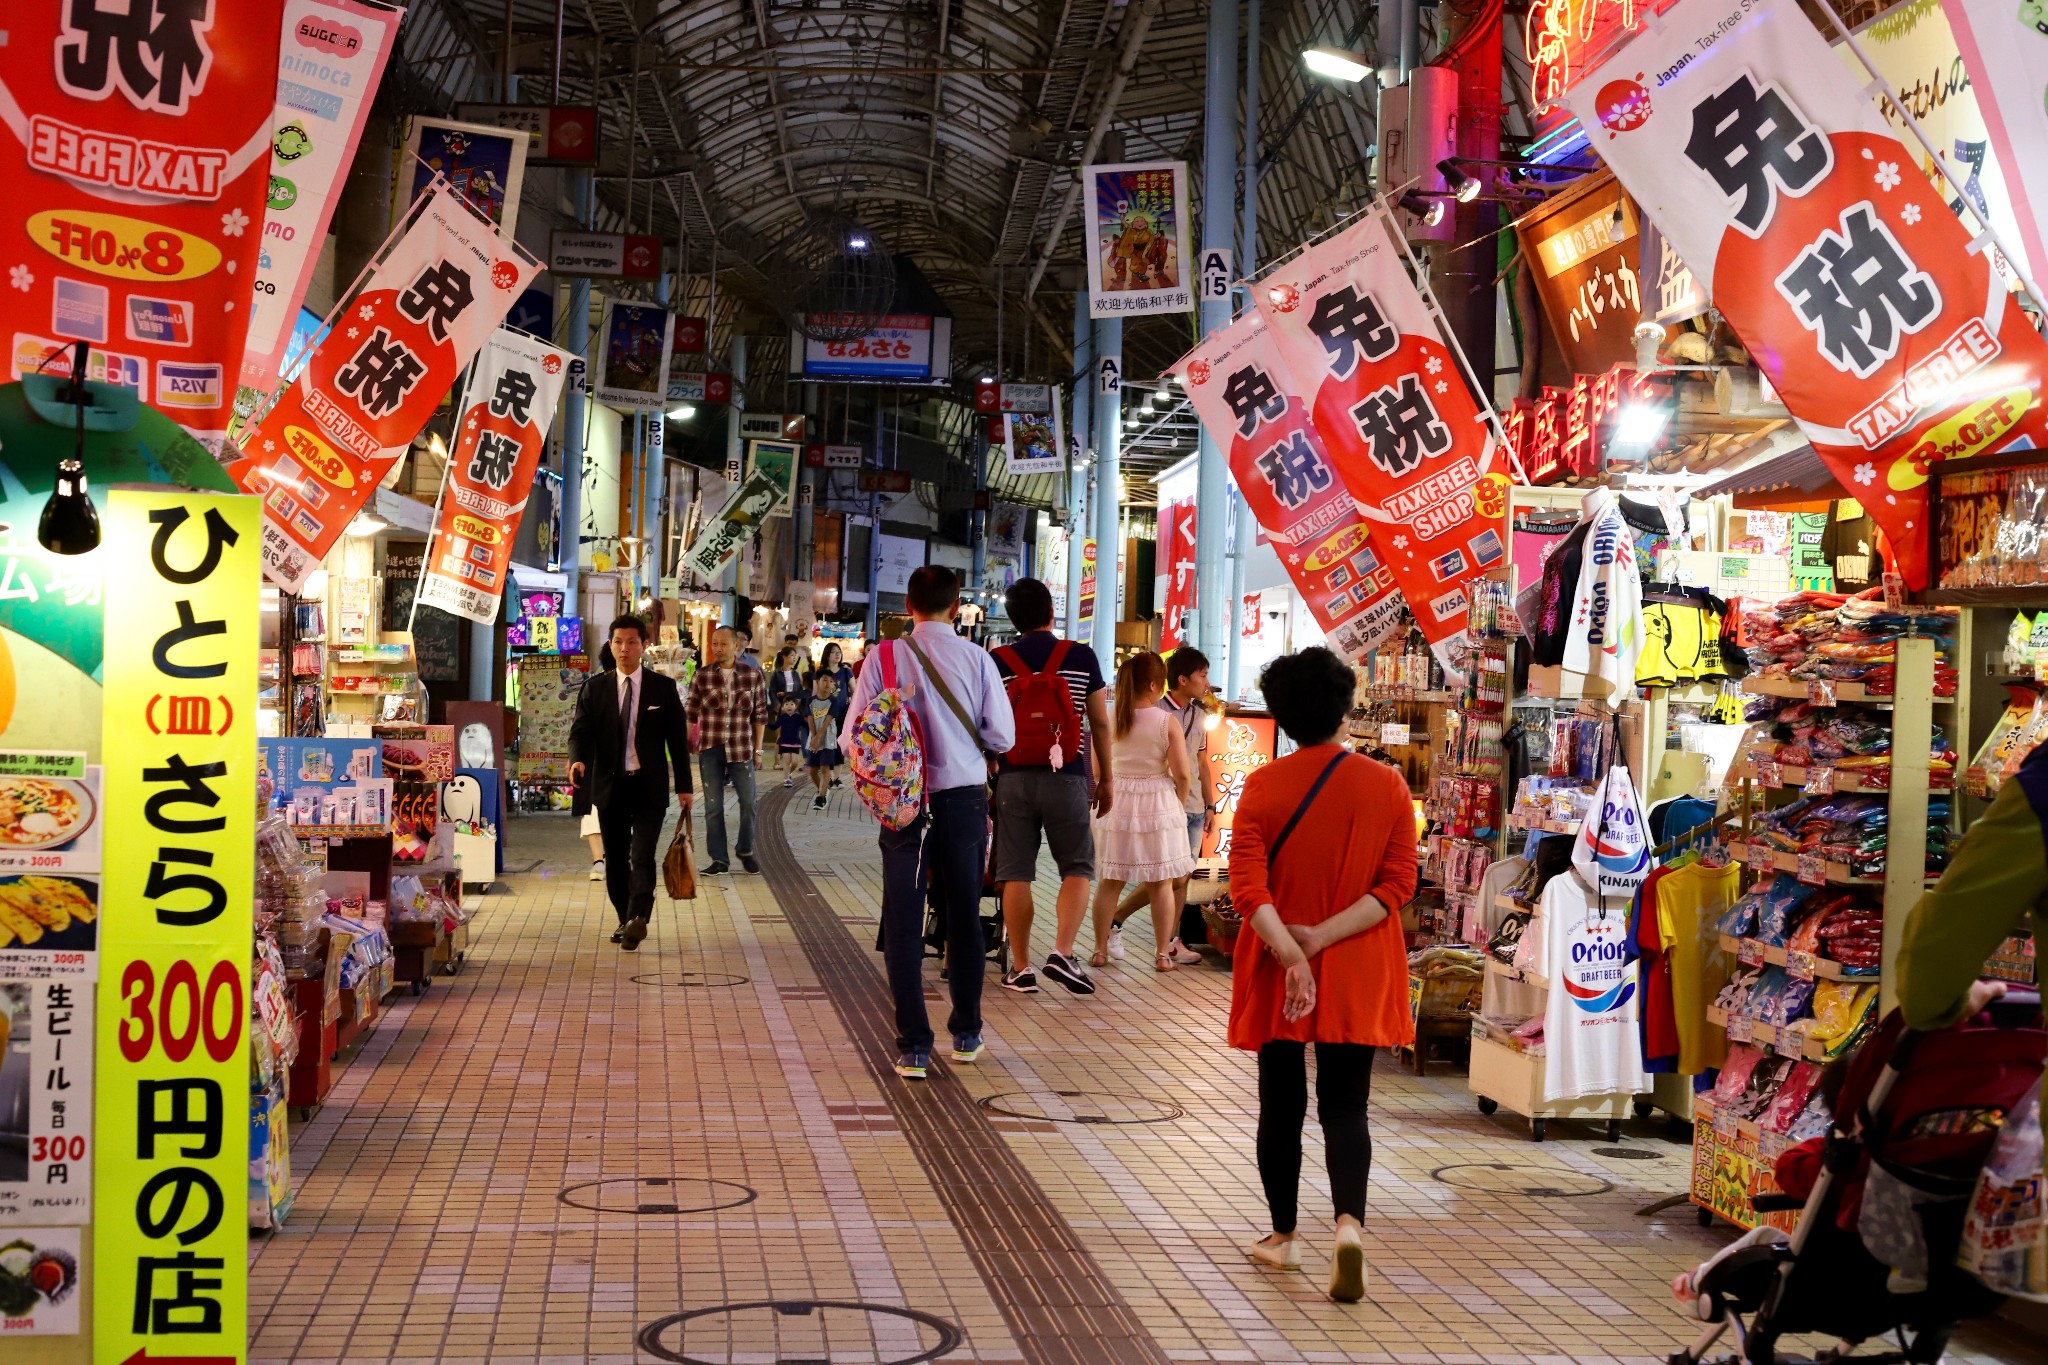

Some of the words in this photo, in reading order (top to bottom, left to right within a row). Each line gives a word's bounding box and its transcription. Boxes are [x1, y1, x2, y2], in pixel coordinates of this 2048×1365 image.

[1656, 53, 1697, 87] Japan.
[1694, 7, 1744, 52] Tax-free
[281, 53, 352, 88] nimoca
[1684, 73, 1934, 371] 免税
[1203, 252, 1228, 274] A
[1303, 273, 1330, 293] Japan.
[1330, 254, 1360, 275] Tax-free
[1359, 243, 1380, 259] Shop
[1204, 276, 1227, 296] 15
[1094, 293, 1190, 312] 欢迎光临和平街
[1569, 254, 1642, 343] ハイビスカ
[827, 339, 912, 359] なみさと
[1213, 350, 1233, 366] Japan.
[569, 359, 586, 374] B
[1100, 359, 1119, 374] A
[569, 376, 586, 391] 14
[1100, 376, 1119, 391] 14
[1307, 284, 1449, 473] 免税
[1852, 391, 1914, 446] TAX
[1907, 325, 1994, 406] FREE
[596, 391, 619, 403] Welcome
[1004, 385, 1044, 398] ドラッグ
[648, 420, 662, 432] B
[742, 419, 780, 433] JUNE
[1222, 364, 1330, 508] 免税
[1907, 394, 2014, 477] 8%OFF
[647, 434, 662, 446] 13
[728, 460, 740, 470] B
[727, 471, 740, 482] 12
[801, 484, 811, 494] B
[1385, 490, 1428, 520] TAX
[1422, 460, 1478, 502] FREE
[1285, 514, 1320, 545] TAX
[1319, 493, 1355, 529] FREE
[1414, 497, 1473, 536] SHOP
[1483, 500, 1504, 516] OF
[697, 529, 734, 572] 泡盛
[1314, 524, 1365, 566] 8%OFF
[1169, 513, 1196, 640] くすり
[1435, 592, 1466, 616] VISA
[1587, 581, 1608, 645] Orion
[1210, 750, 1269, 767] ハイビスカス
[30, 856, 62, 867] 300円
[1599, 874, 1643, 888] KINAW
[53, 953, 85, 964] 300円
[1581, 969, 1604, 983] DRAFT
[1604, 969, 1622, 981] BEER
[118, 959, 244, 1063] 300
[46, 983, 75, 1090] 生ビール
[50, 1100, 66, 1129] 毎日
[31, 1135, 86, 1163] 300
[1694, 1117, 1716, 1202] 激安価格
[46, 1163, 68, 1185] 円
[1714, 1149, 1747, 1189] 大人
[131, 1077, 225, 1335] 円の店
[3, 1318, 35, 1330] 300円
